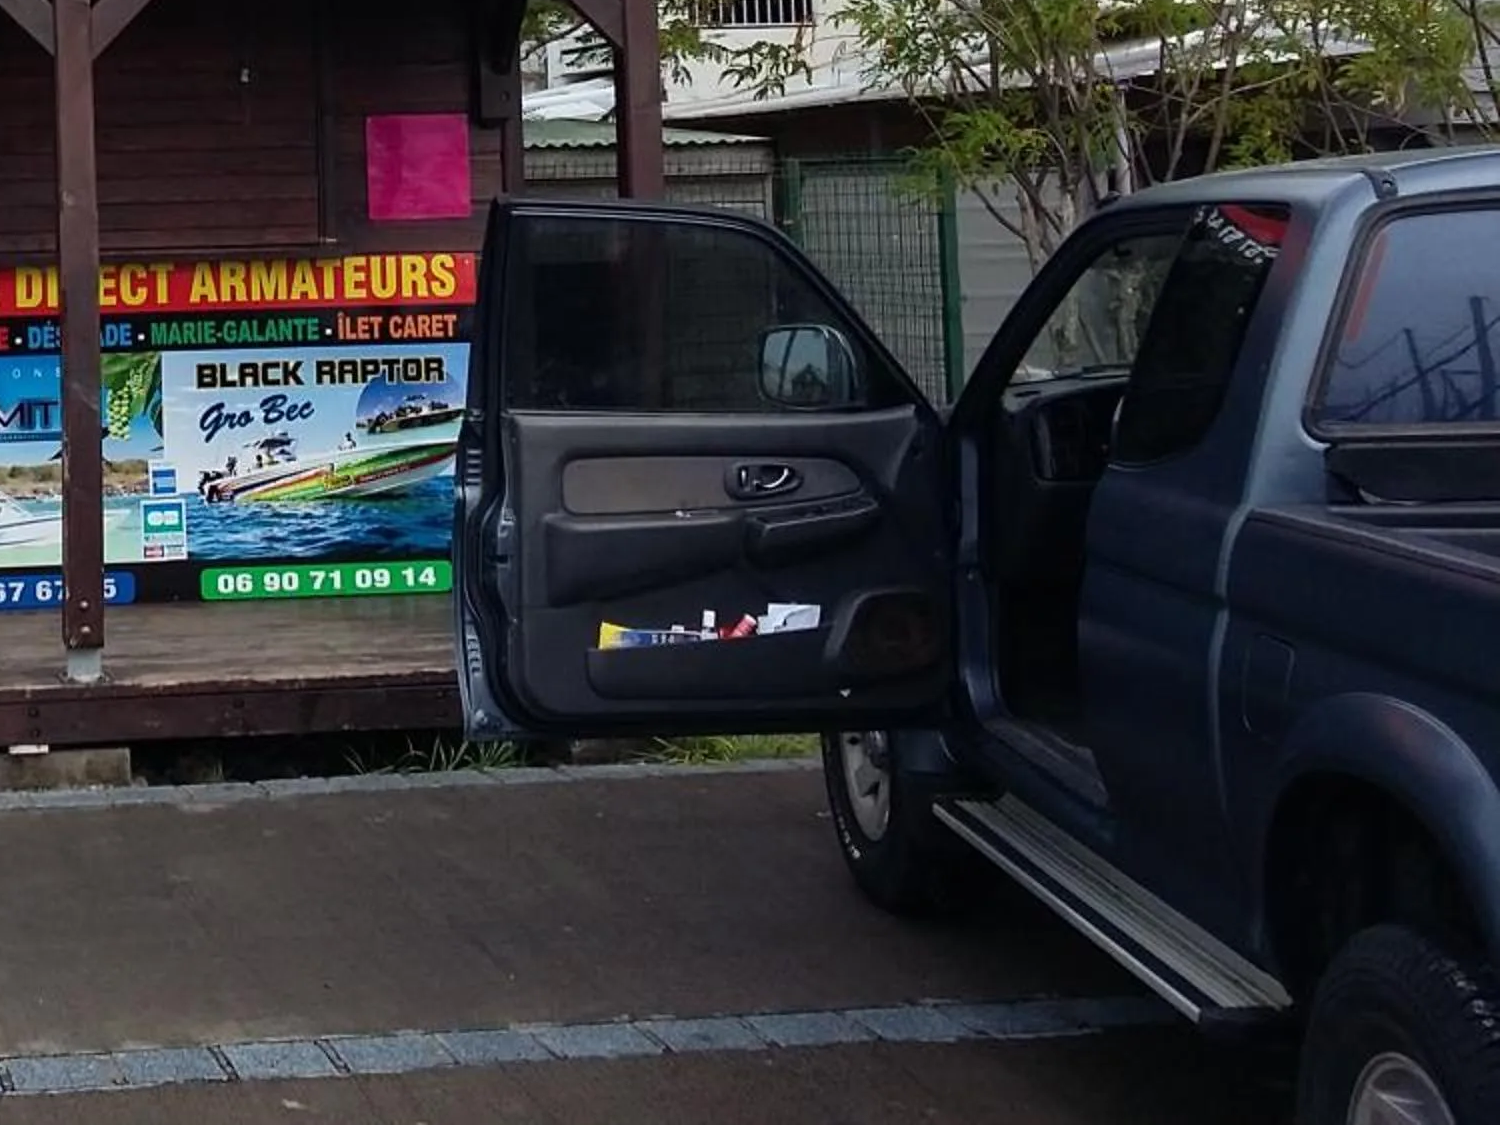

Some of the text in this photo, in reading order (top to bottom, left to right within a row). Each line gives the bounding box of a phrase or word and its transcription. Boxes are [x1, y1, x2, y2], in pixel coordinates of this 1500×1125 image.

[15, 263, 175, 308] DIECT
[189, 254, 458, 304] ARMATEURS
[150, 317, 320, 347] MARIE-GALANTE
[337, 311, 383, 340] ÎLET
[389, 314, 457, 338] CARET
[196, 356, 446, 389] BLACK RAPTOR
[199, 393, 315, 443] Gro Bec
[217, 566, 436, 594] 06 90 71 09 14
